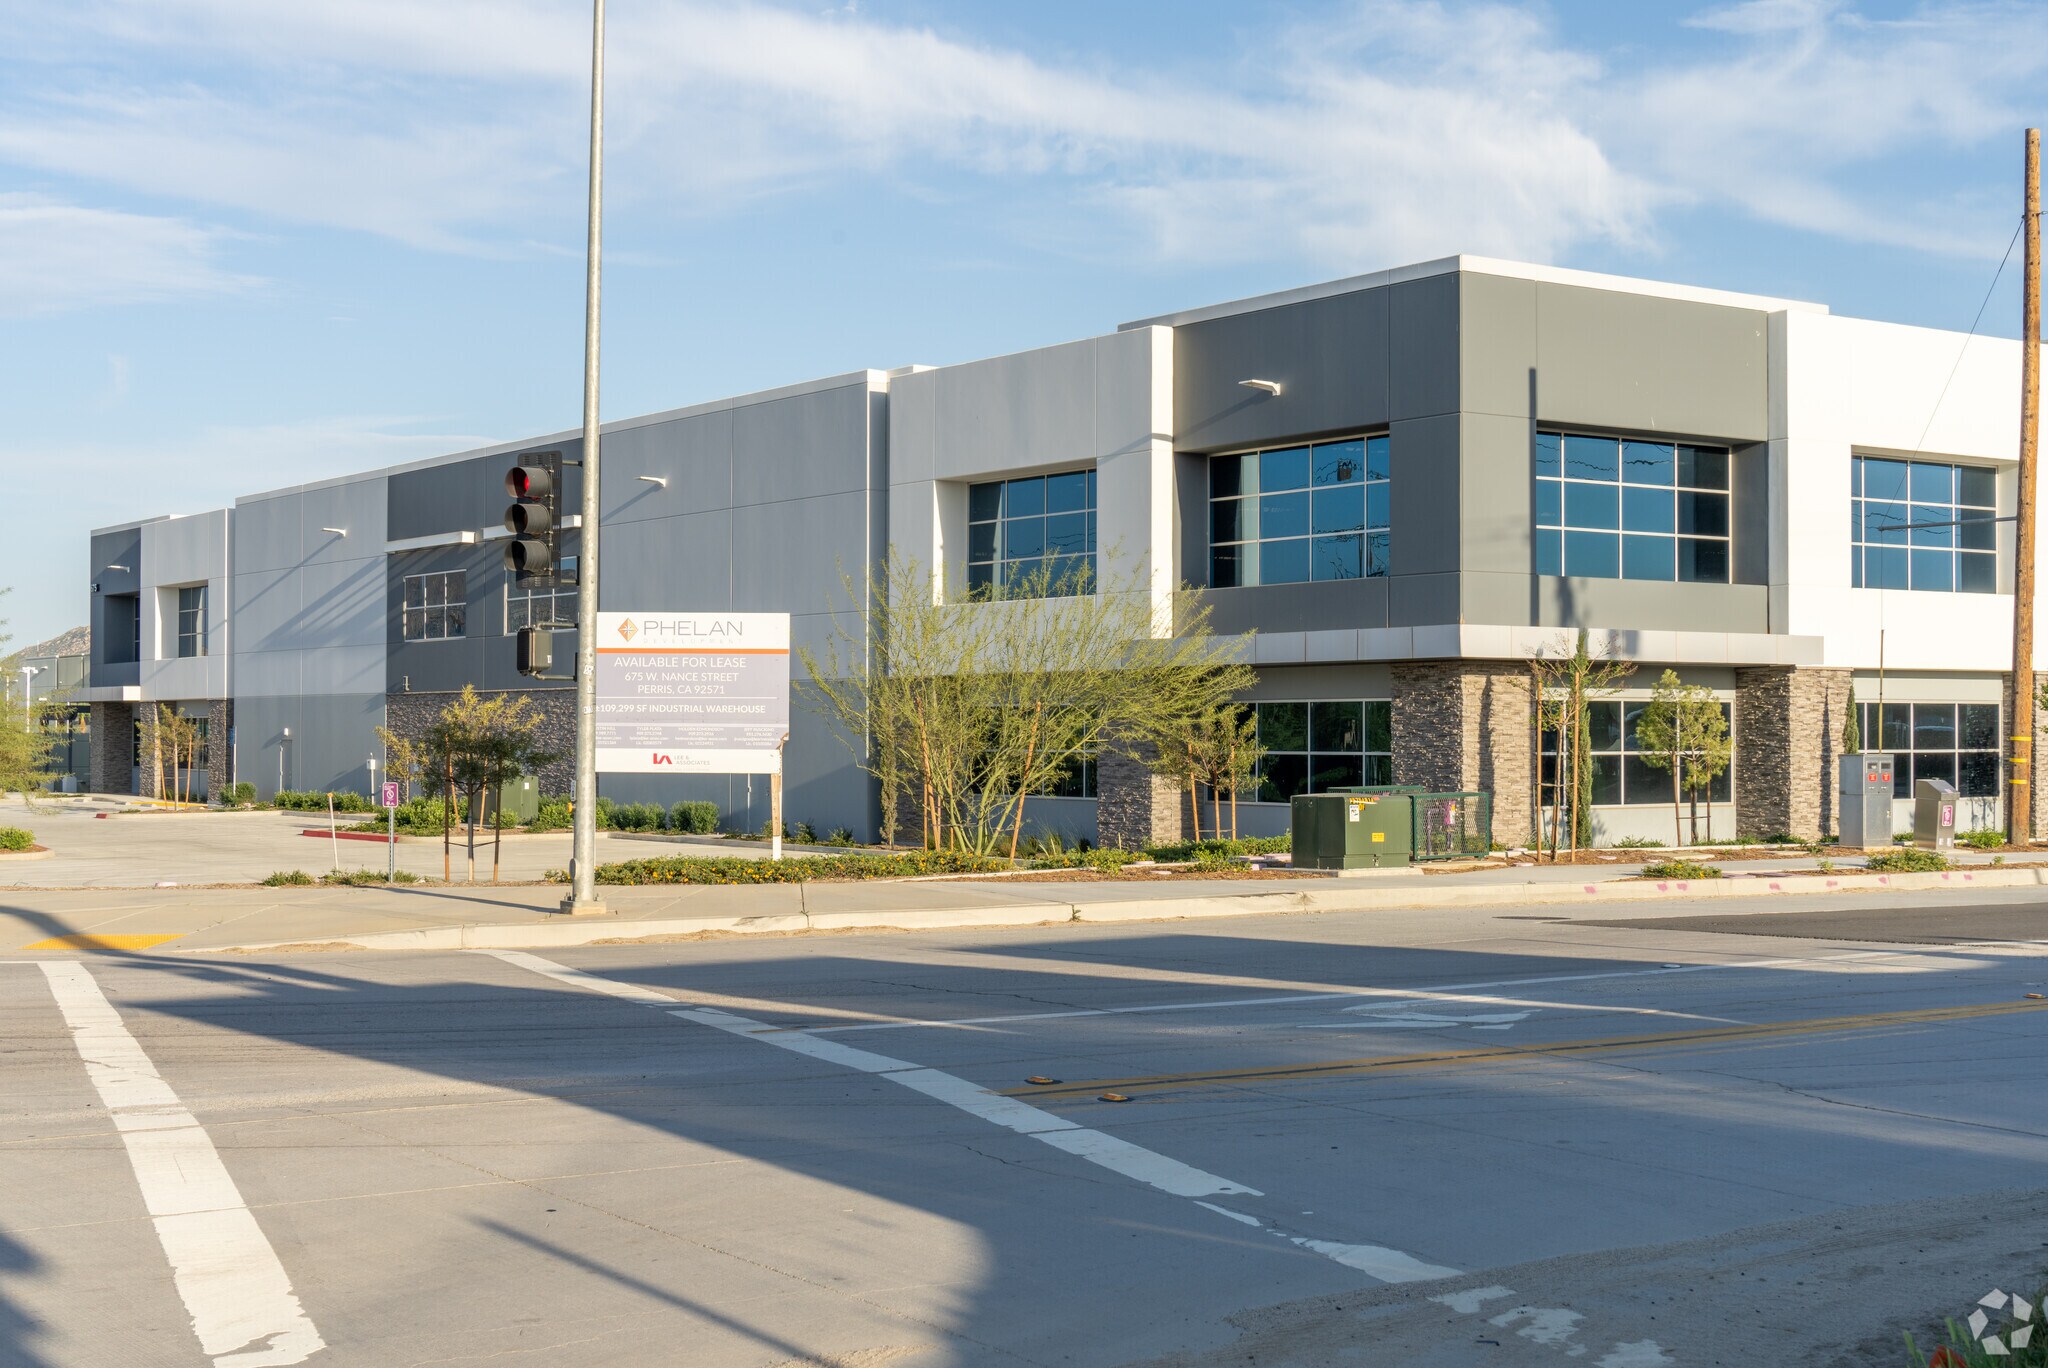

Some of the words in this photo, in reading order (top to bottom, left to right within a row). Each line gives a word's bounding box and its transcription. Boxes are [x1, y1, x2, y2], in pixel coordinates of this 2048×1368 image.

[643, 620, 743, 636] PHELAN
[614, 656, 679, 668] AVAILABLE
[682, 657, 707, 668] FOR
[710, 657, 747, 669] LEASE
[624, 672, 643, 681] 675
[646, 672, 659, 681] W.
[661, 672, 698, 682] NANCE
[701, 672, 739, 682] STREET
[637, 684, 675, 695] PERRIS,
[677, 685, 691, 694] CA
[694, 685, 725, 695] 92571
[636, 704, 647, 713] SF
[649, 704, 704, 713] INDUSTRIAL
[705, 704, 766, 714] WAREHOUSE
